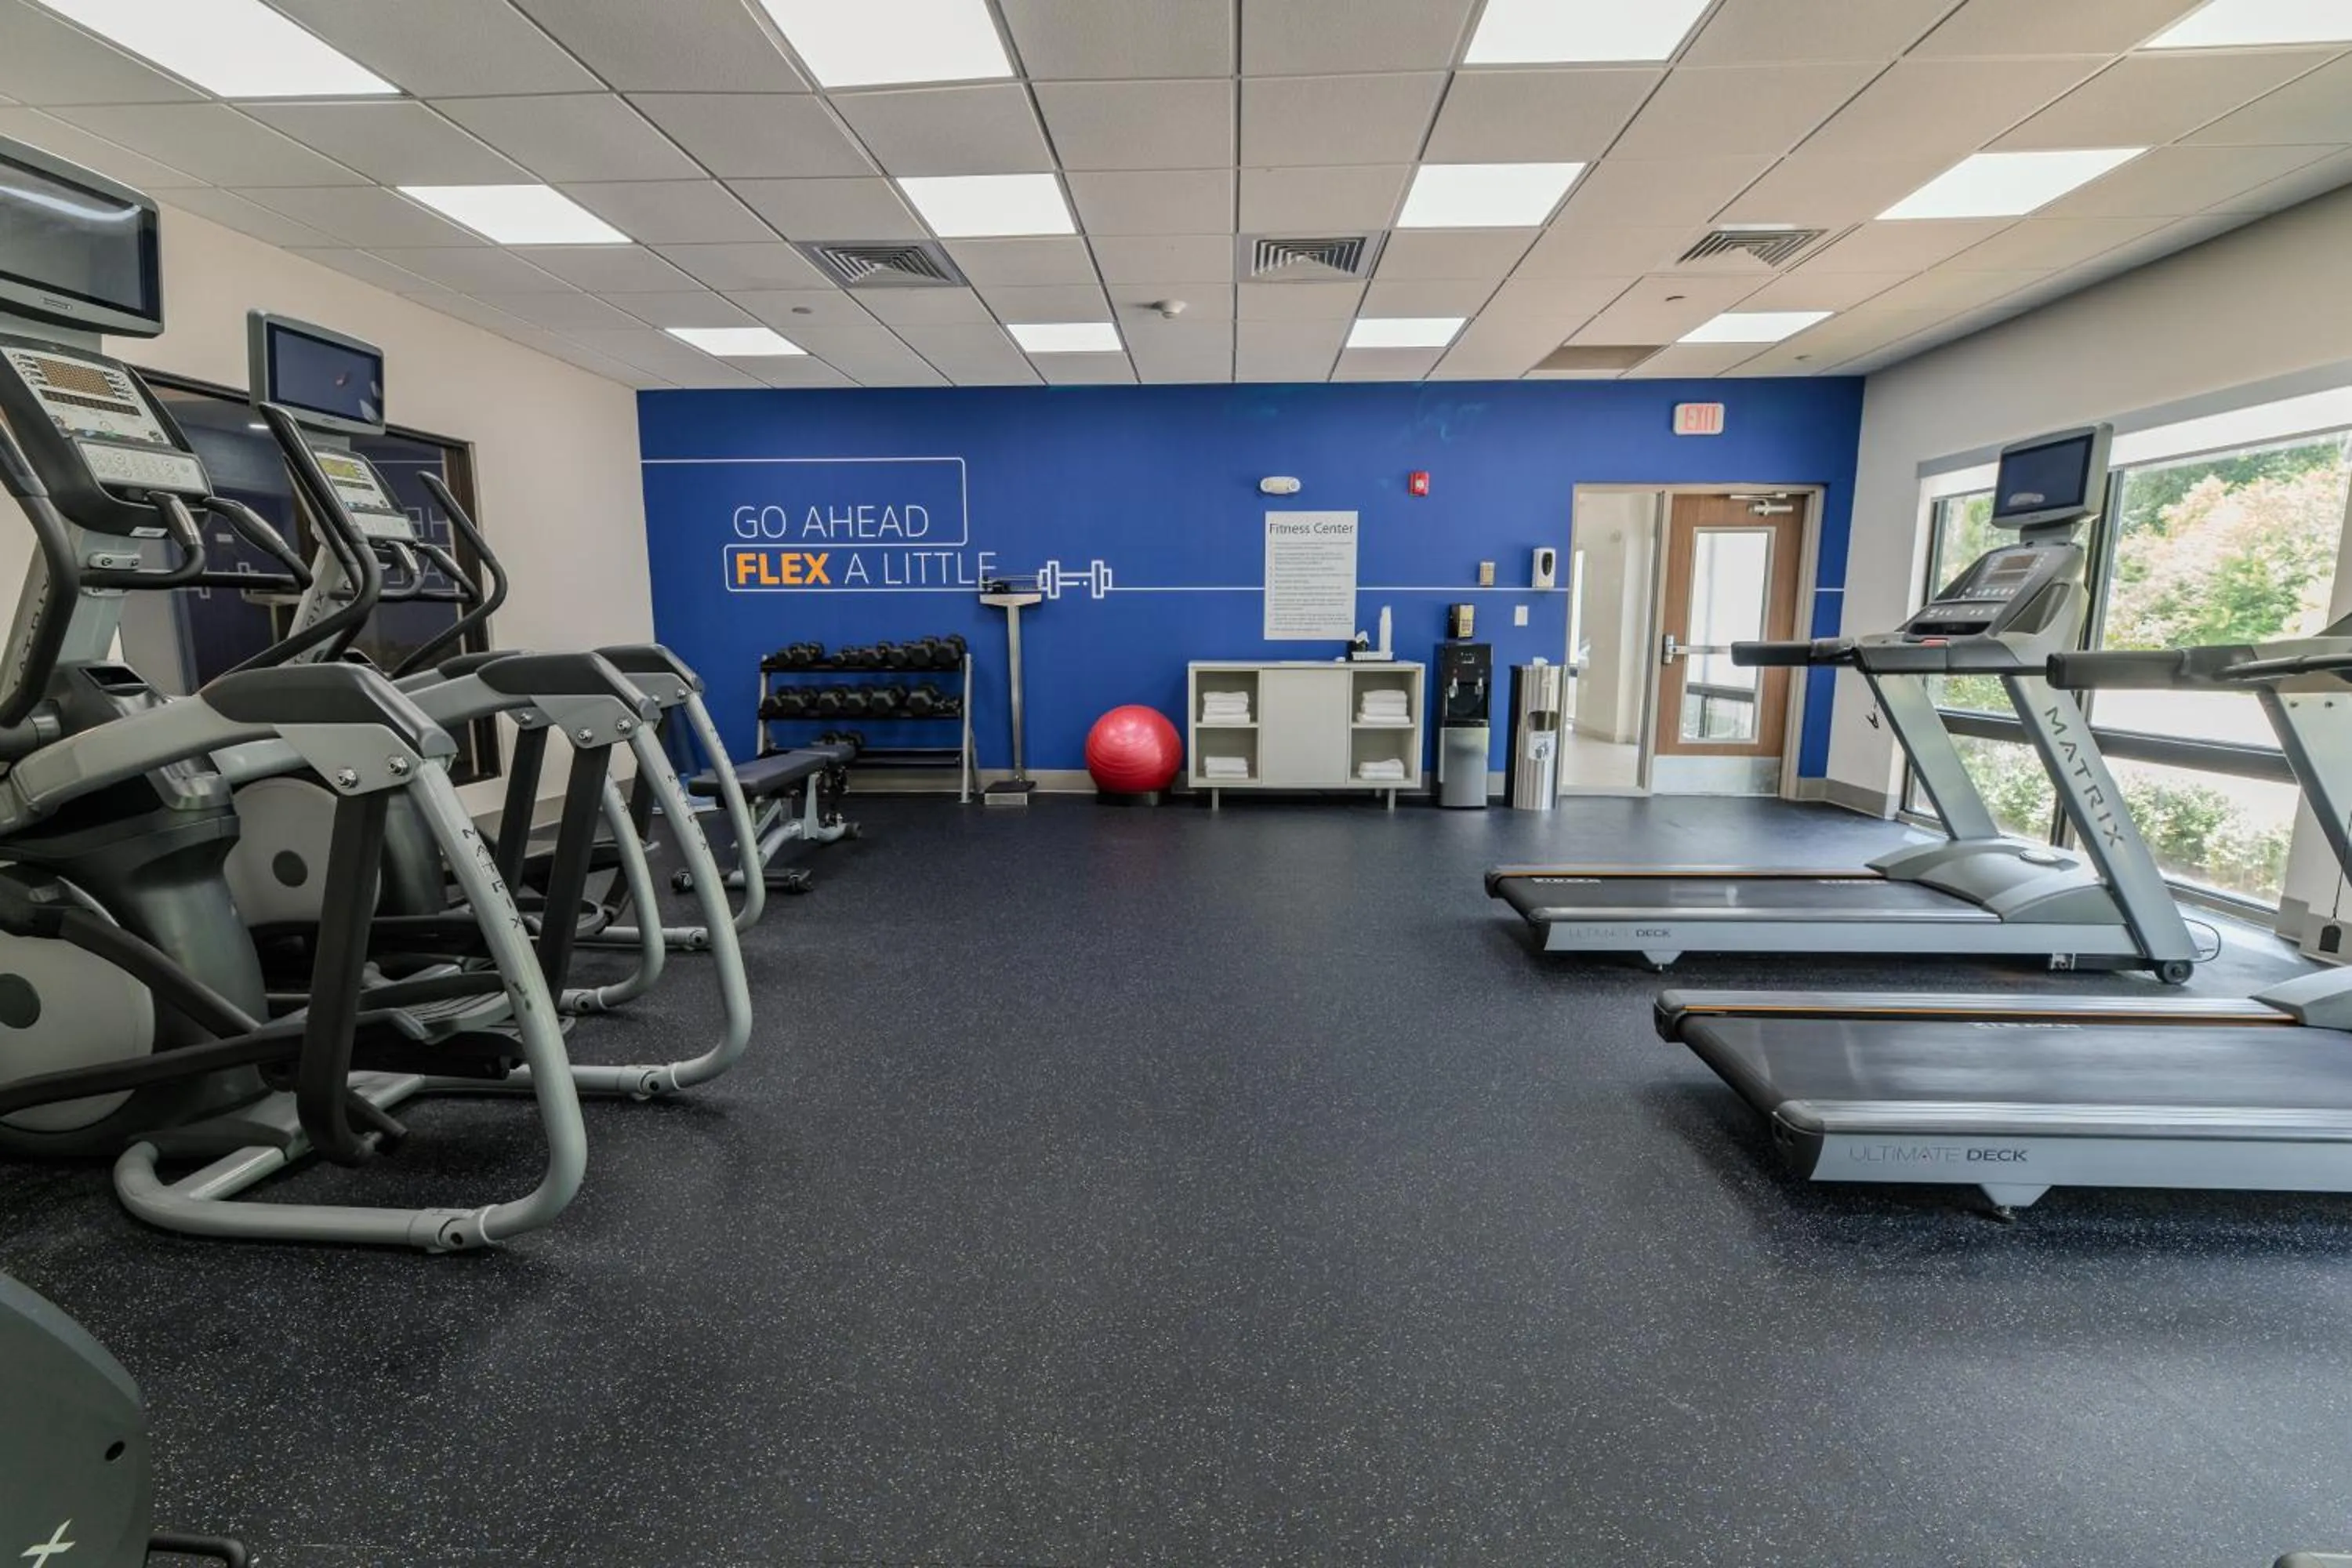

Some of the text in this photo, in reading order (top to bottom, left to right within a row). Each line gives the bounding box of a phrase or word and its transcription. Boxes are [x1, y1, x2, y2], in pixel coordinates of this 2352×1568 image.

[733, 505, 930, 539] GO AHEAD
[1269, 523, 1354, 535] Fitness Center
[735, 551, 997, 586] FLEX A LITTLE
[2044, 706, 2125, 848] MATRIX
[1635, 928, 1671, 938] DECK
[1849, 1144, 2029, 1163] ULTIMATE DECK
